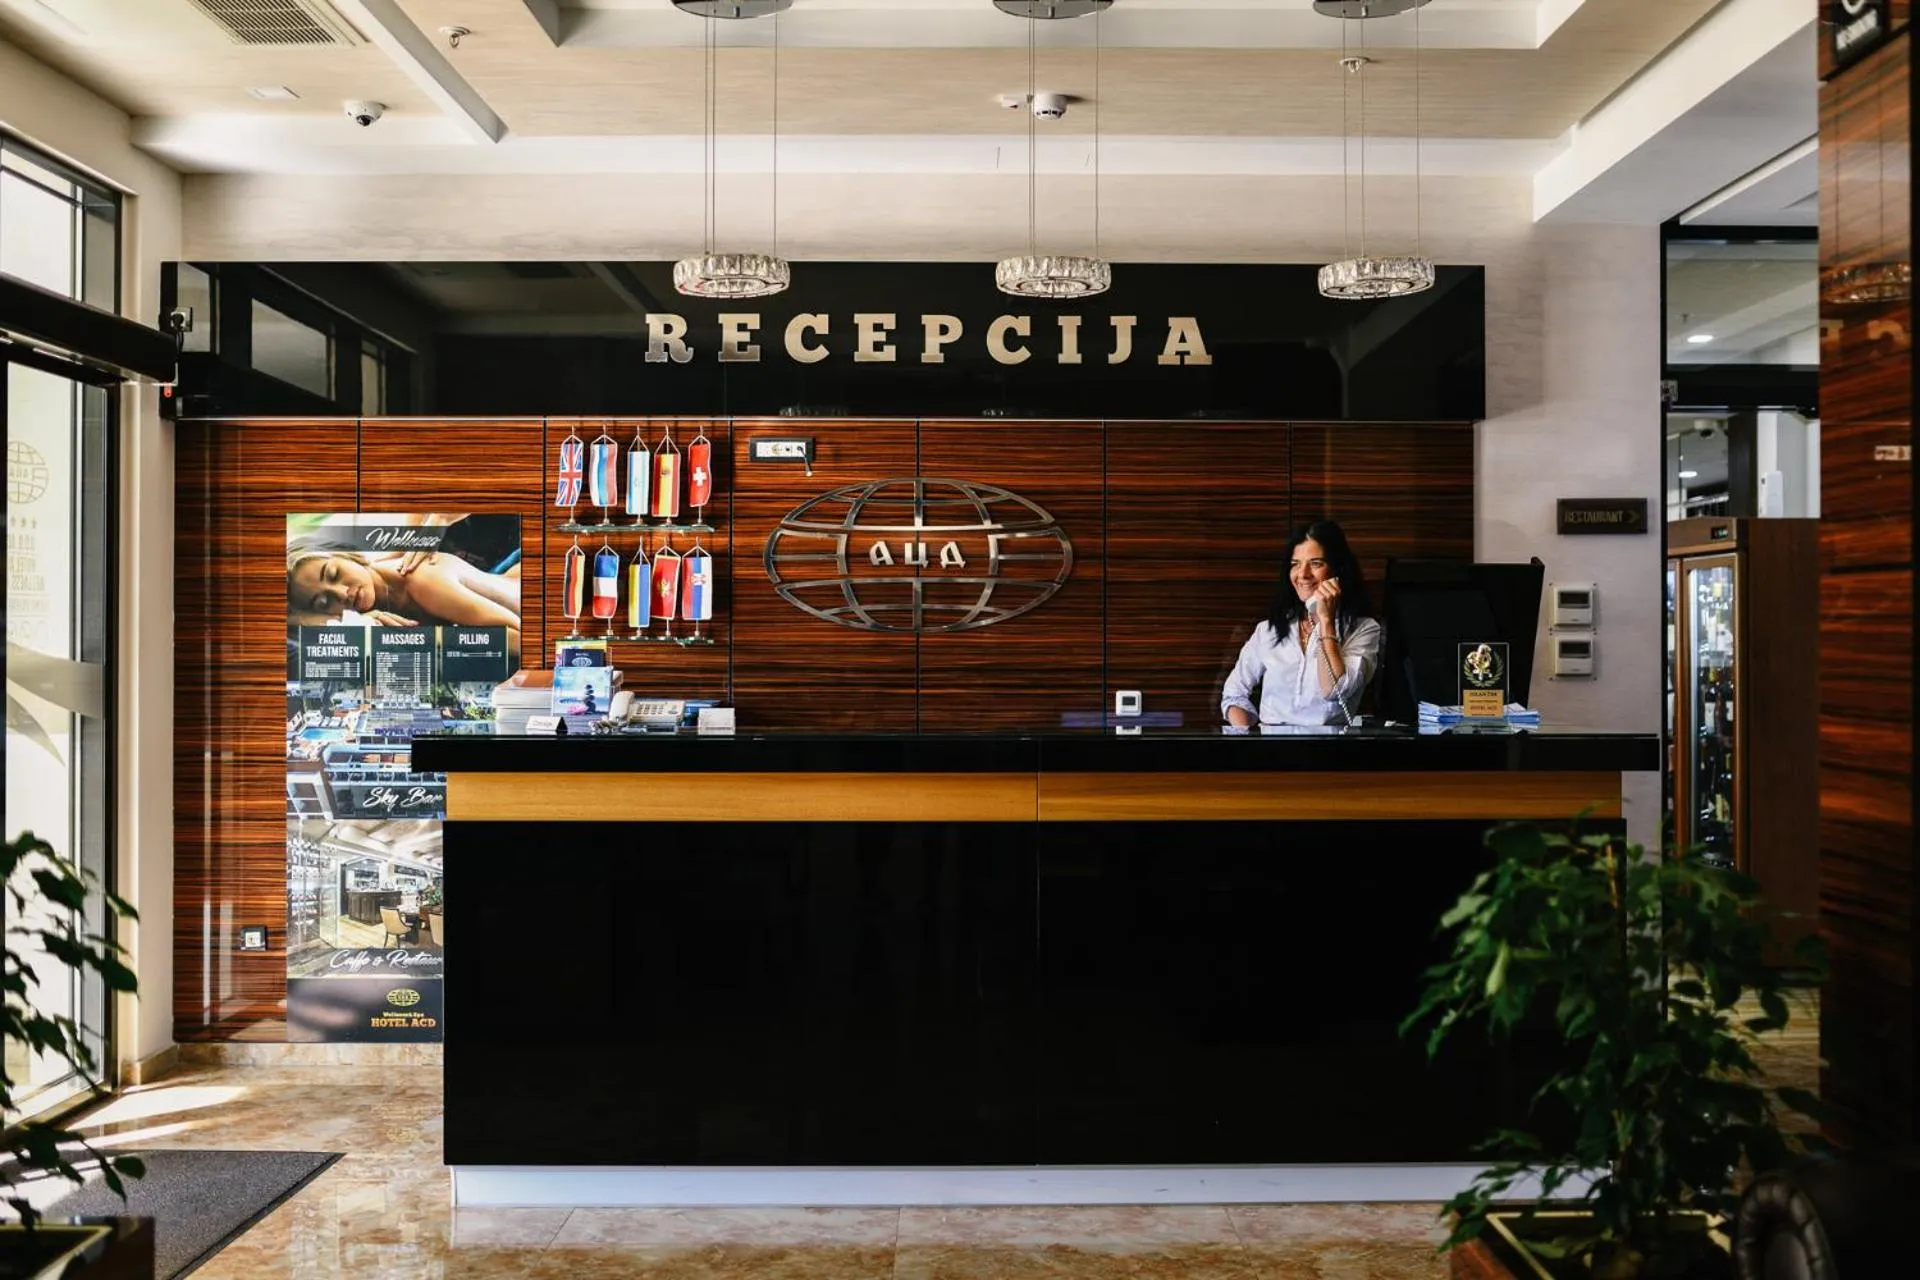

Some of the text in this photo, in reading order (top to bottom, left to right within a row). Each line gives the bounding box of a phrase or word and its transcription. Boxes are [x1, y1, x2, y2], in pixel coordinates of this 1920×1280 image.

[645, 313, 1212, 365] RECEPCIJA
[365, 527, 441, 551] Wellness
[318, 633, 347, 645] FACIAL
[381, 633, 426, 645] MASSAGES
[458, 634, 490, 645] PILLING
[306, 646, 359, 658] TREATMENTS
[363, 787, 443, 812] Sky Bar
[370, 1018, 437, 1028] HOTEL ACD
